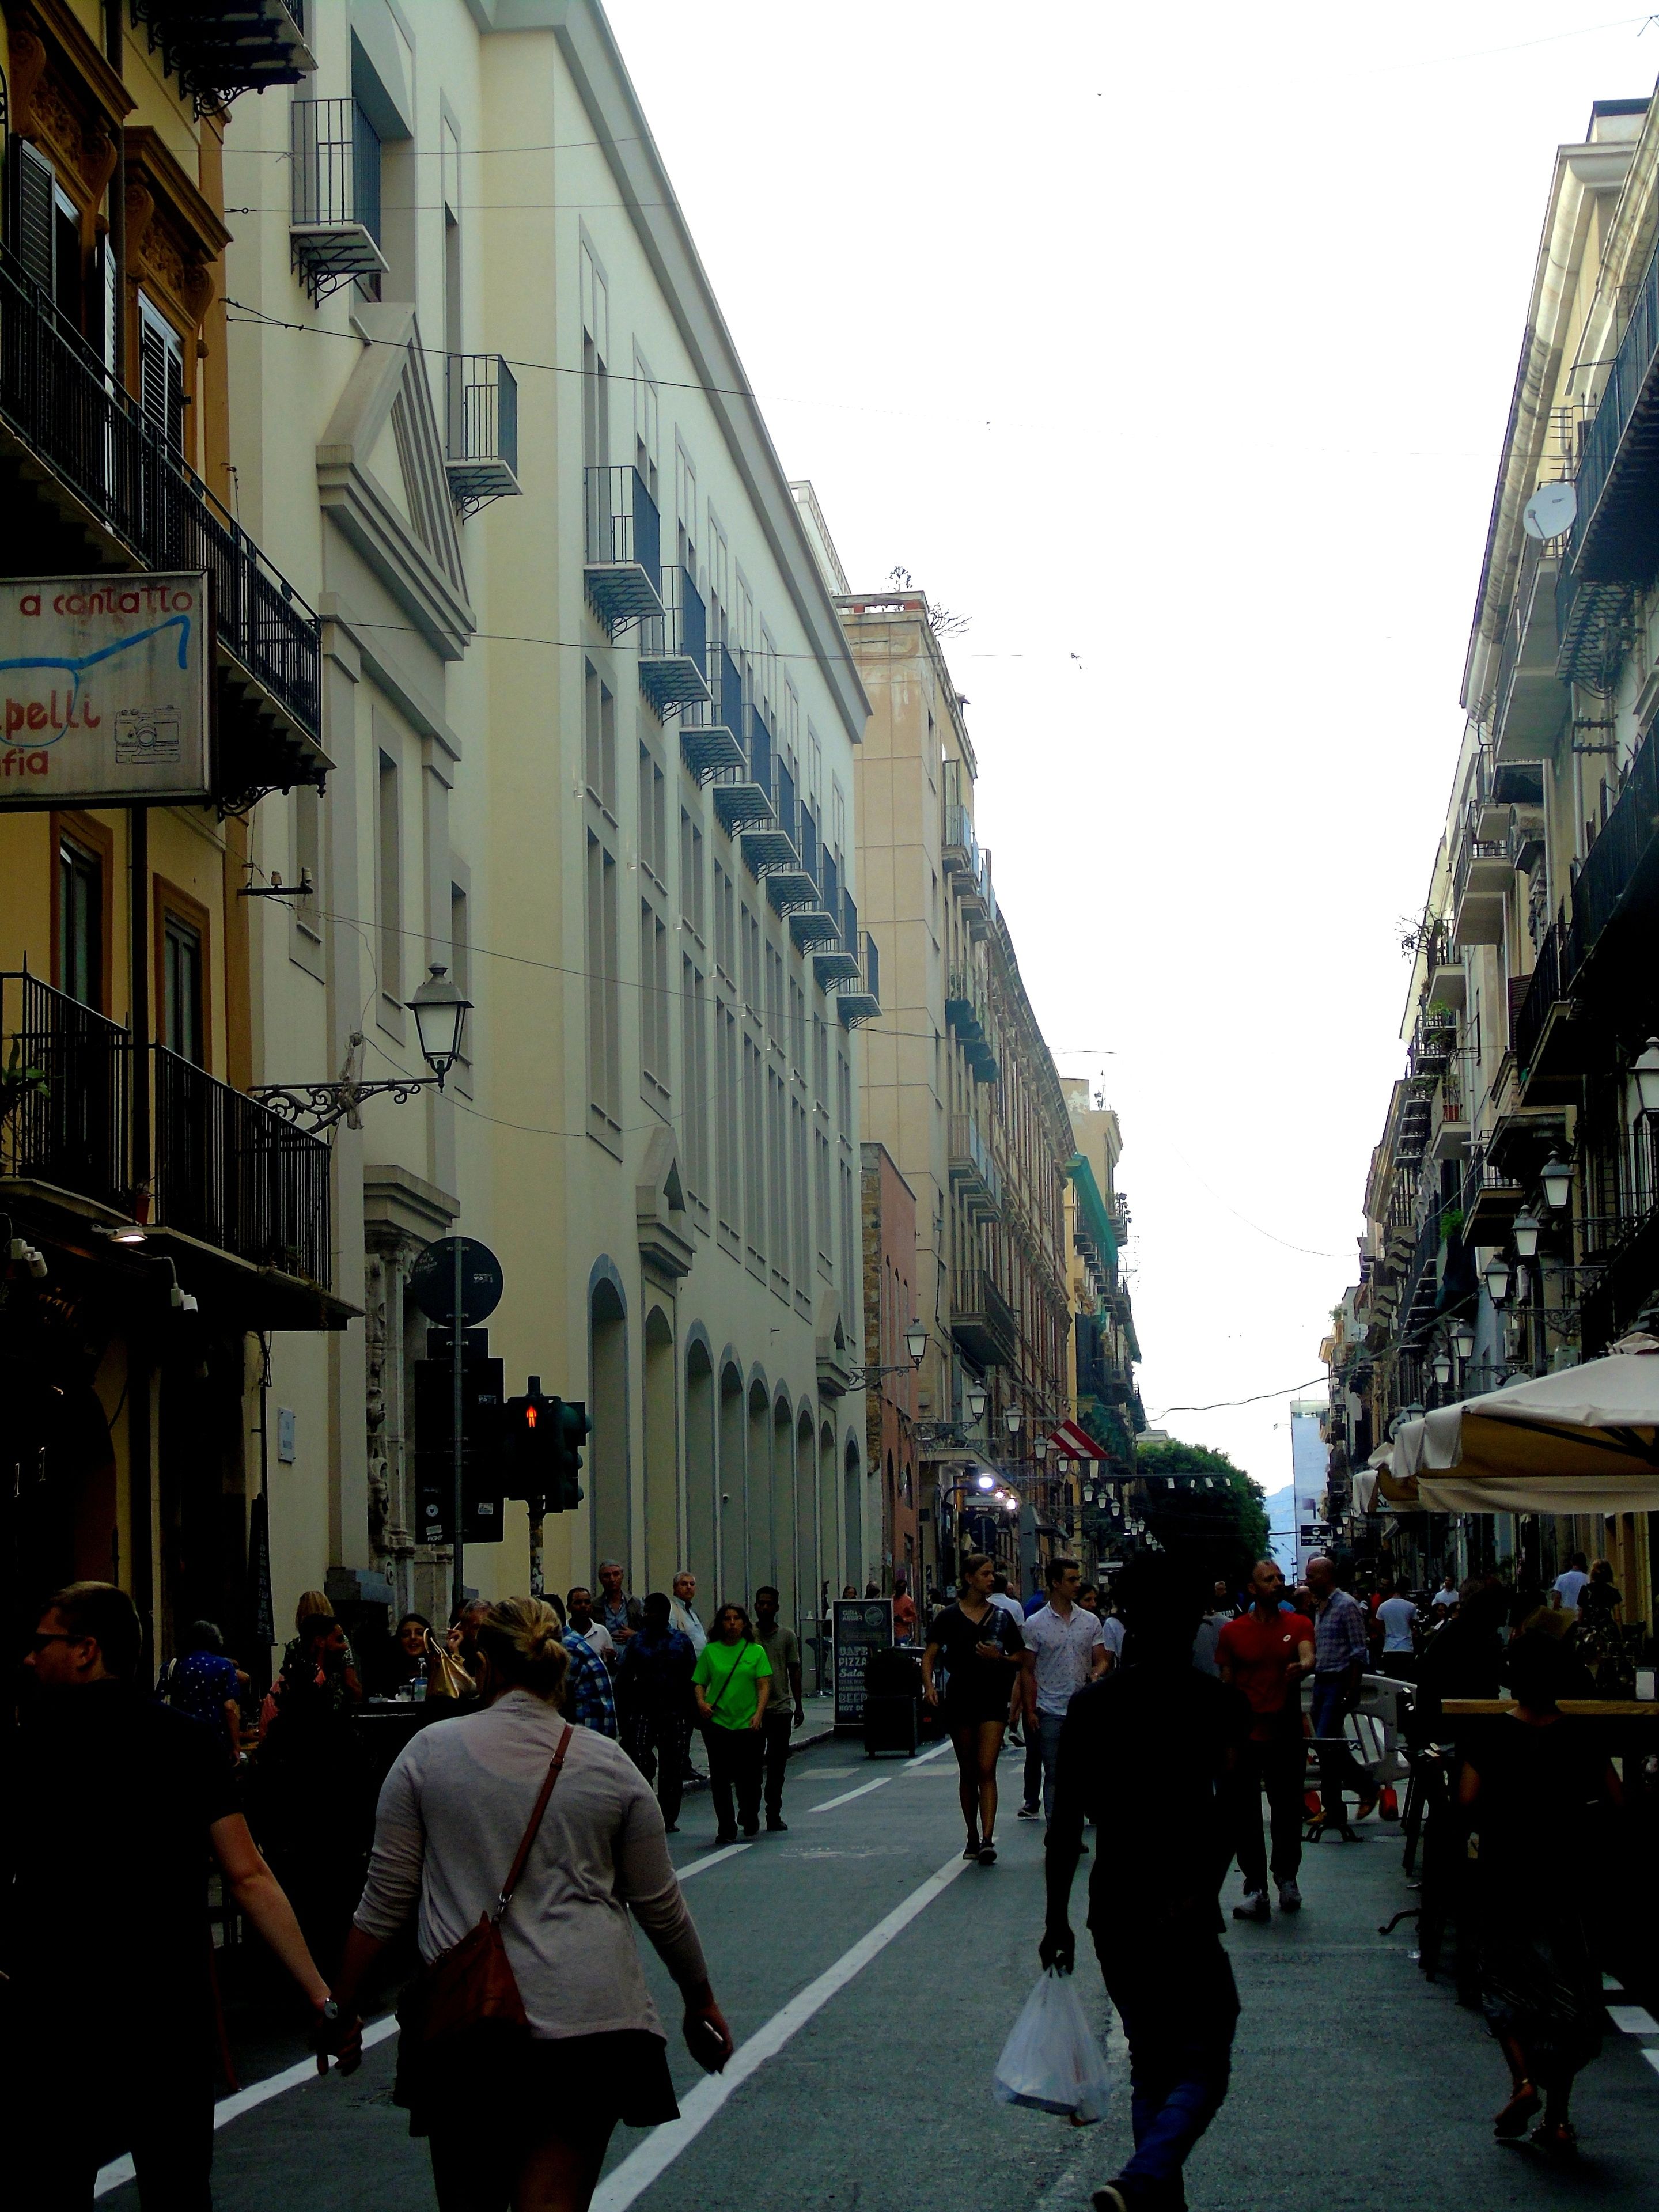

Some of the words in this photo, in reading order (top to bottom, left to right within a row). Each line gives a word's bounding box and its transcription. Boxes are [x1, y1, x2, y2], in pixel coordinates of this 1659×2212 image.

[20, 594, 40, 616] a
[53, 585, 193, 615] contatto
[839, 1668, 865, 1677] Sala
